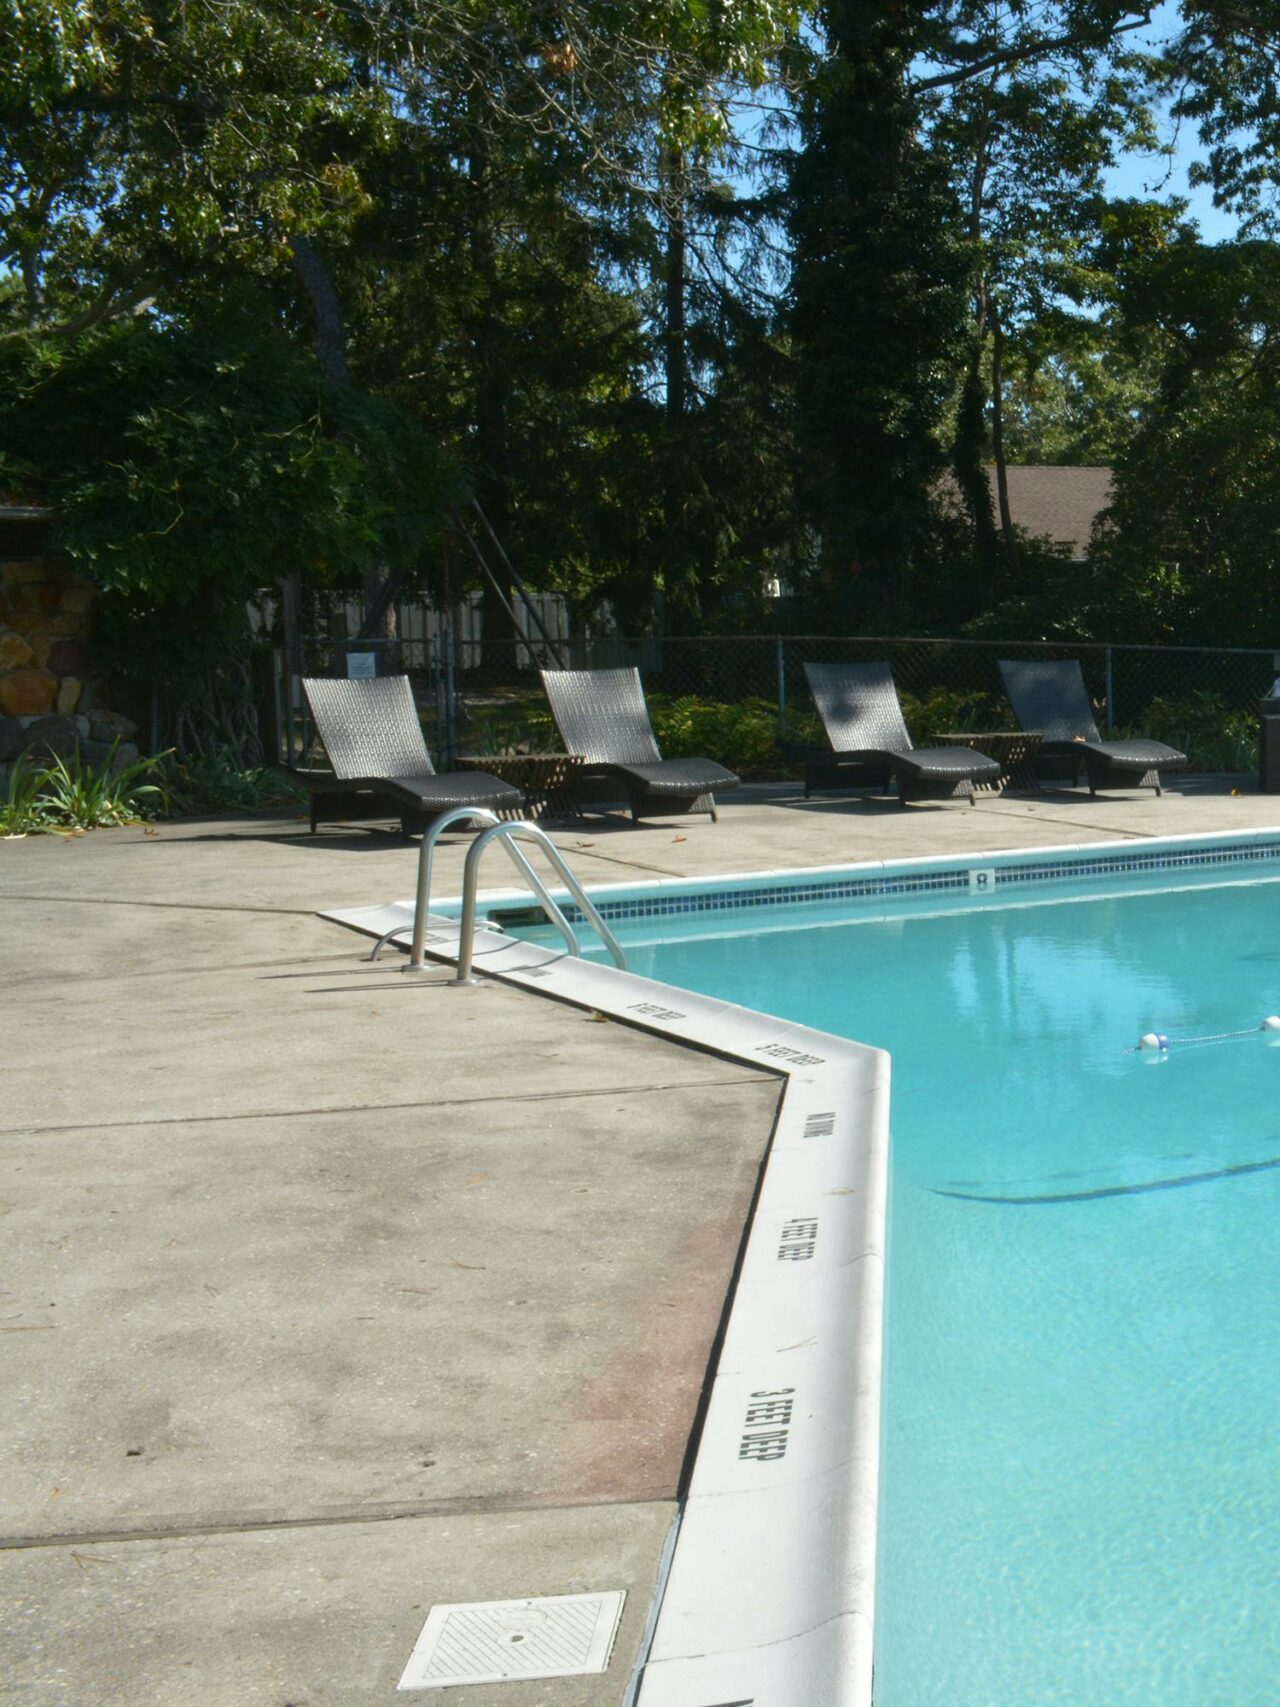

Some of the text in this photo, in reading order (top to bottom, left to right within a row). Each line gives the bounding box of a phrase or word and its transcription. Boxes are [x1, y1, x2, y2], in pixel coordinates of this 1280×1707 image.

[762, 1046, 803, 1059] FEET
[785, 1054, 826, 1066] DEEP
[780, 1223, 818, 1242] FEET
[777, 1241, 816, 1261] DEEP
[738, 1388, 796, 1461] 3 FEET DEEP
